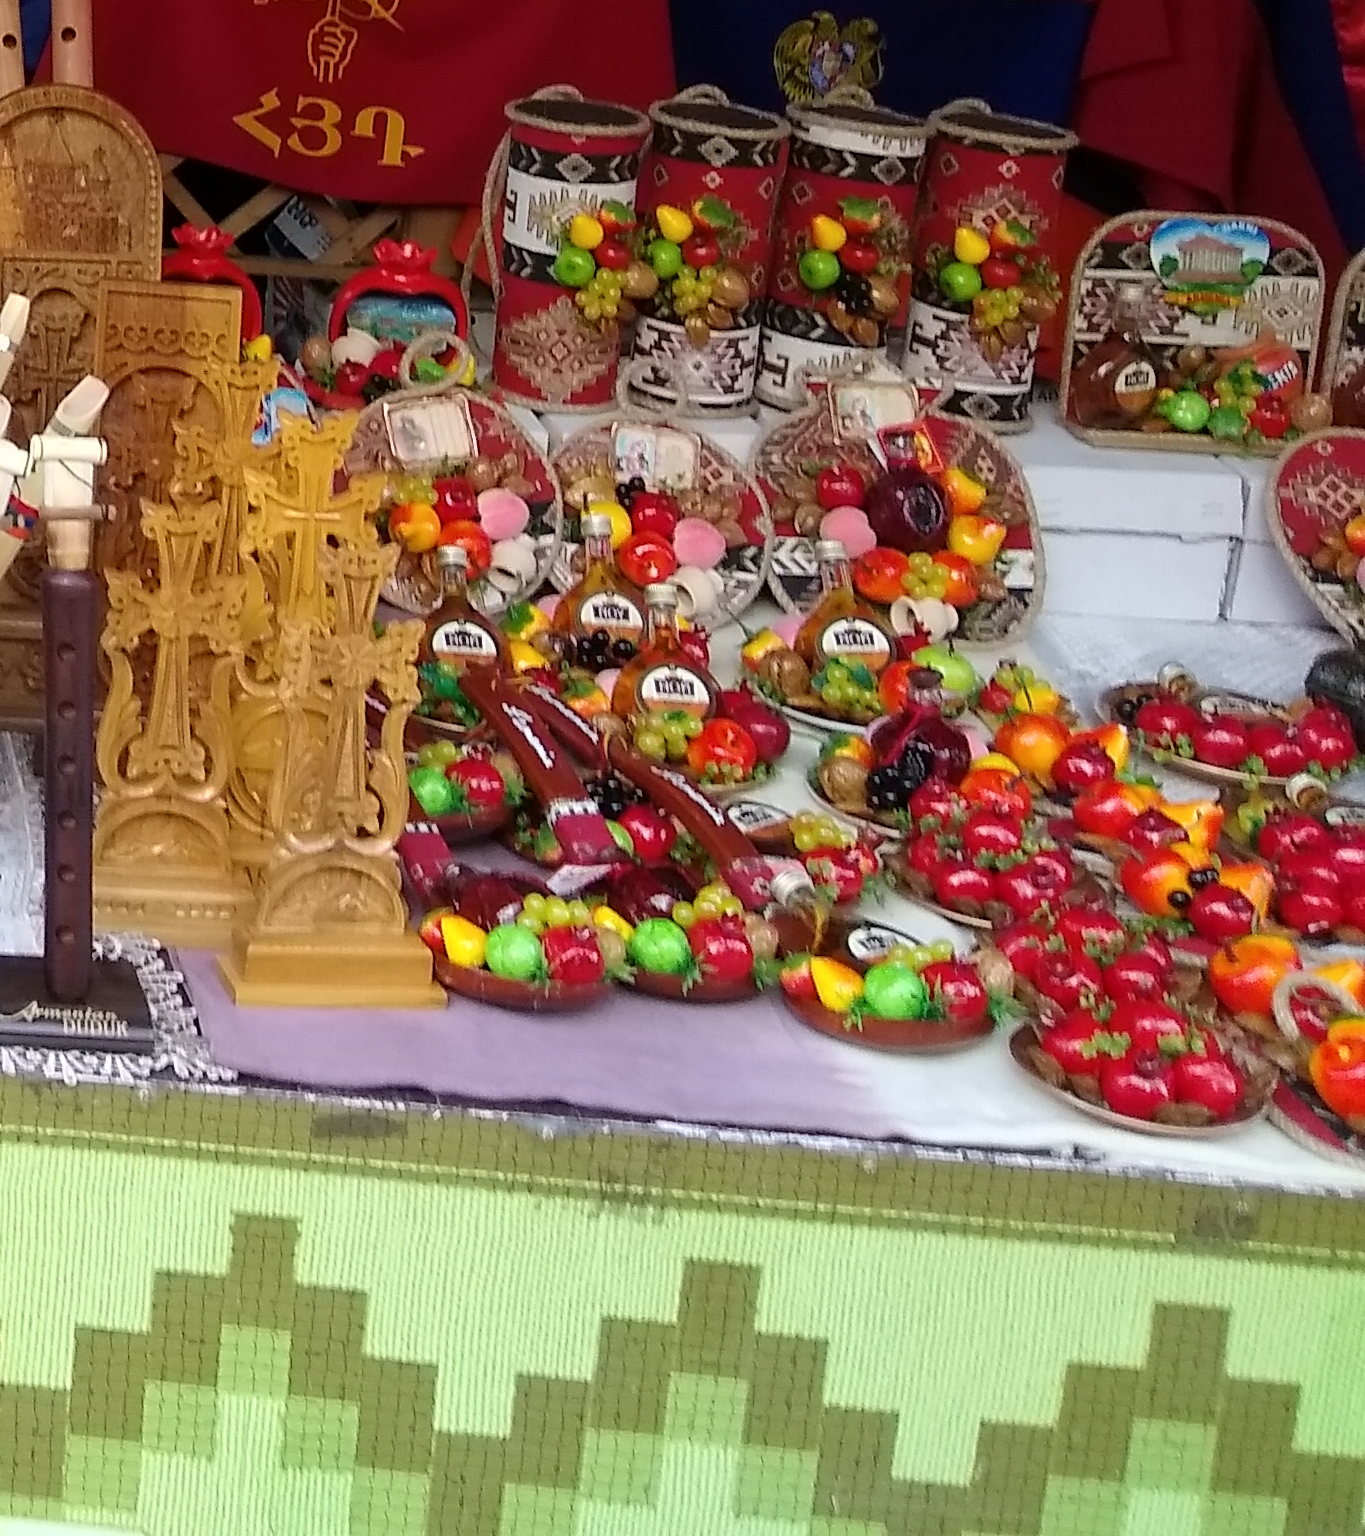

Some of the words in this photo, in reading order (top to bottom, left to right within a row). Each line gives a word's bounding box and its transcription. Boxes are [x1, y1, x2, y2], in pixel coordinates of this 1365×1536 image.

[231, 86, 425, 167] ՀՅԴ
[0, 1000, 117, 1023] Armenian
[63, 1018, 129, 1039] DUDUK
